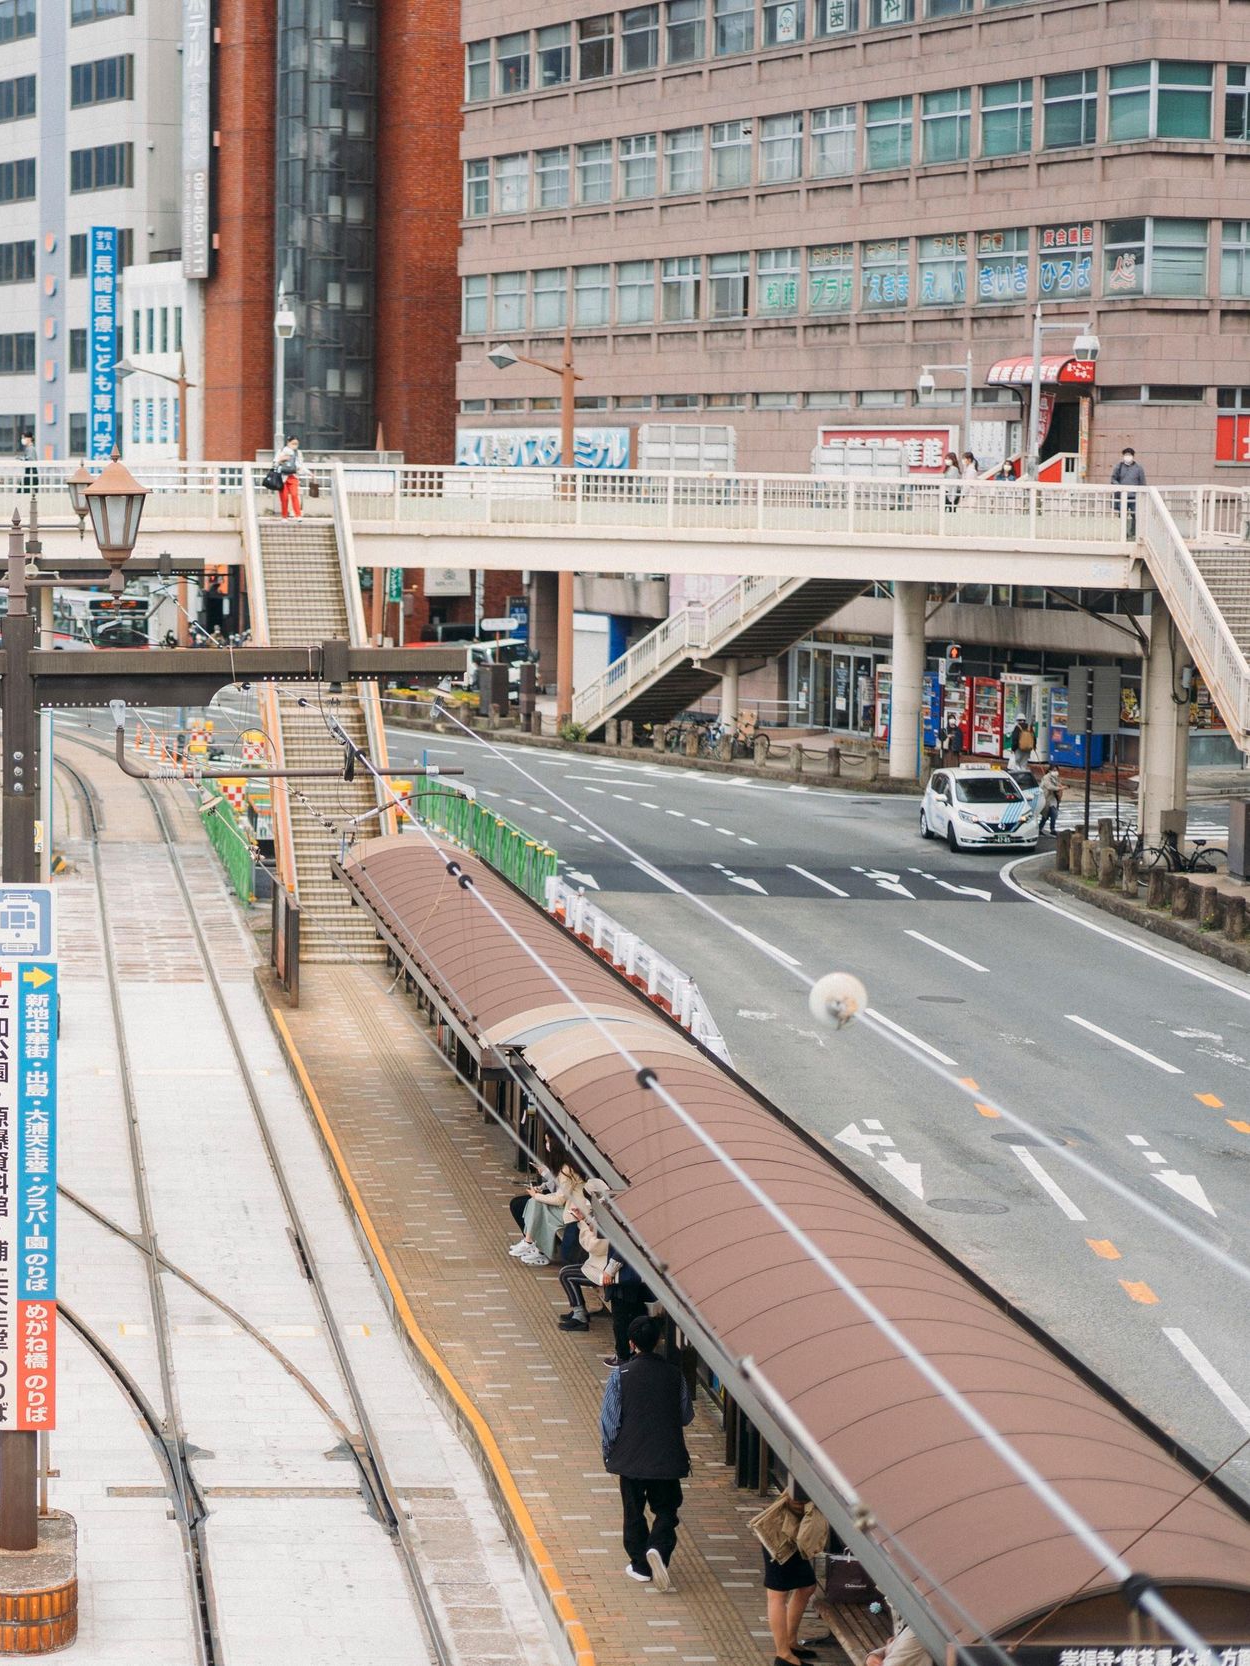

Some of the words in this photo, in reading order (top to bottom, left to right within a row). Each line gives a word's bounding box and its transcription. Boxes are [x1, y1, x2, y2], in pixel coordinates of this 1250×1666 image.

[480, 434, 627, 467] 県営バスタミナル
